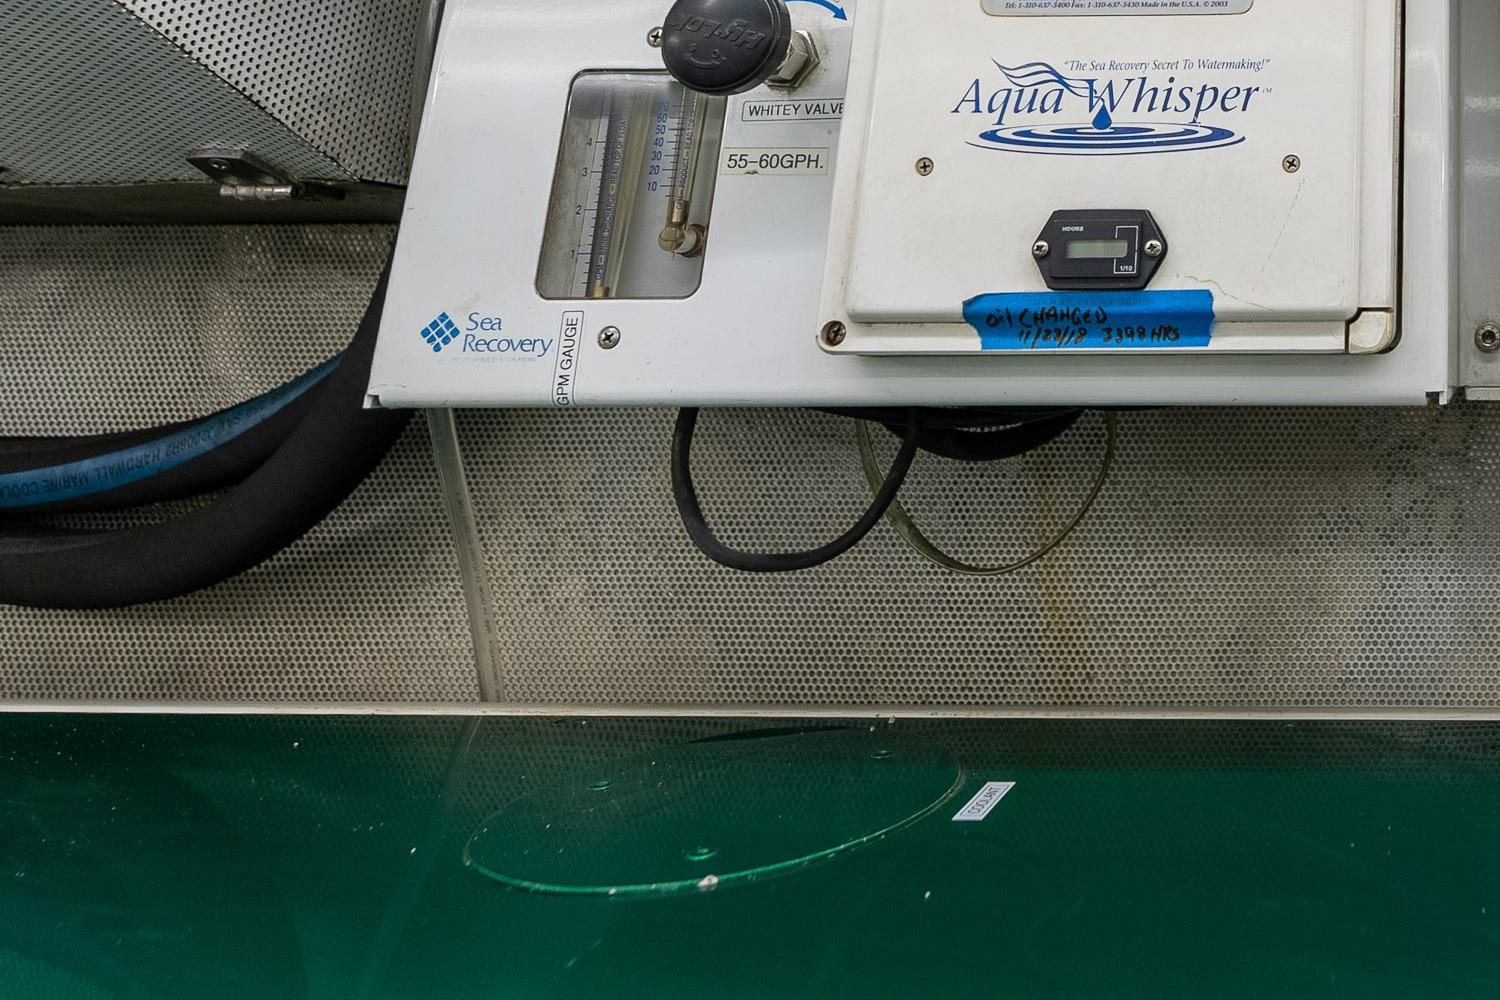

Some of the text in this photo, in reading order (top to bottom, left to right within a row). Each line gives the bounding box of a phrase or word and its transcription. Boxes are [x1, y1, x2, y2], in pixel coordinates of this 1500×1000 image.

[1089, 60, 1106, 70] Sea
[1108, 60, 1149, 72] Recovery
[1152, 60, 1179, 70] Secret
[1182, 60, 1194, 70] To
[951, 76, 1260, 126] Aqua Whisper
[748, 104, 802, 116] WHITEY
[657, 113, 668, 122] 60
[655, 124, 666, 134] 50
[653, 138, 664, 147] 40
[651, 152, 662, 161] 30
[582, 168, 588, 177] 3
[650, 165, 660, 175] 20
[648, 182, 658, 192] 10
[466, 312, 502, 331] Sea
[463, 334, 553, 357] Recovery
[556, 317, 579, 406] GPM GAUGE
[96, 452, 160, 480] HARDWALL
[45, 473, 90, 492] MARINE
[0, 483, 38, 498] COOL
